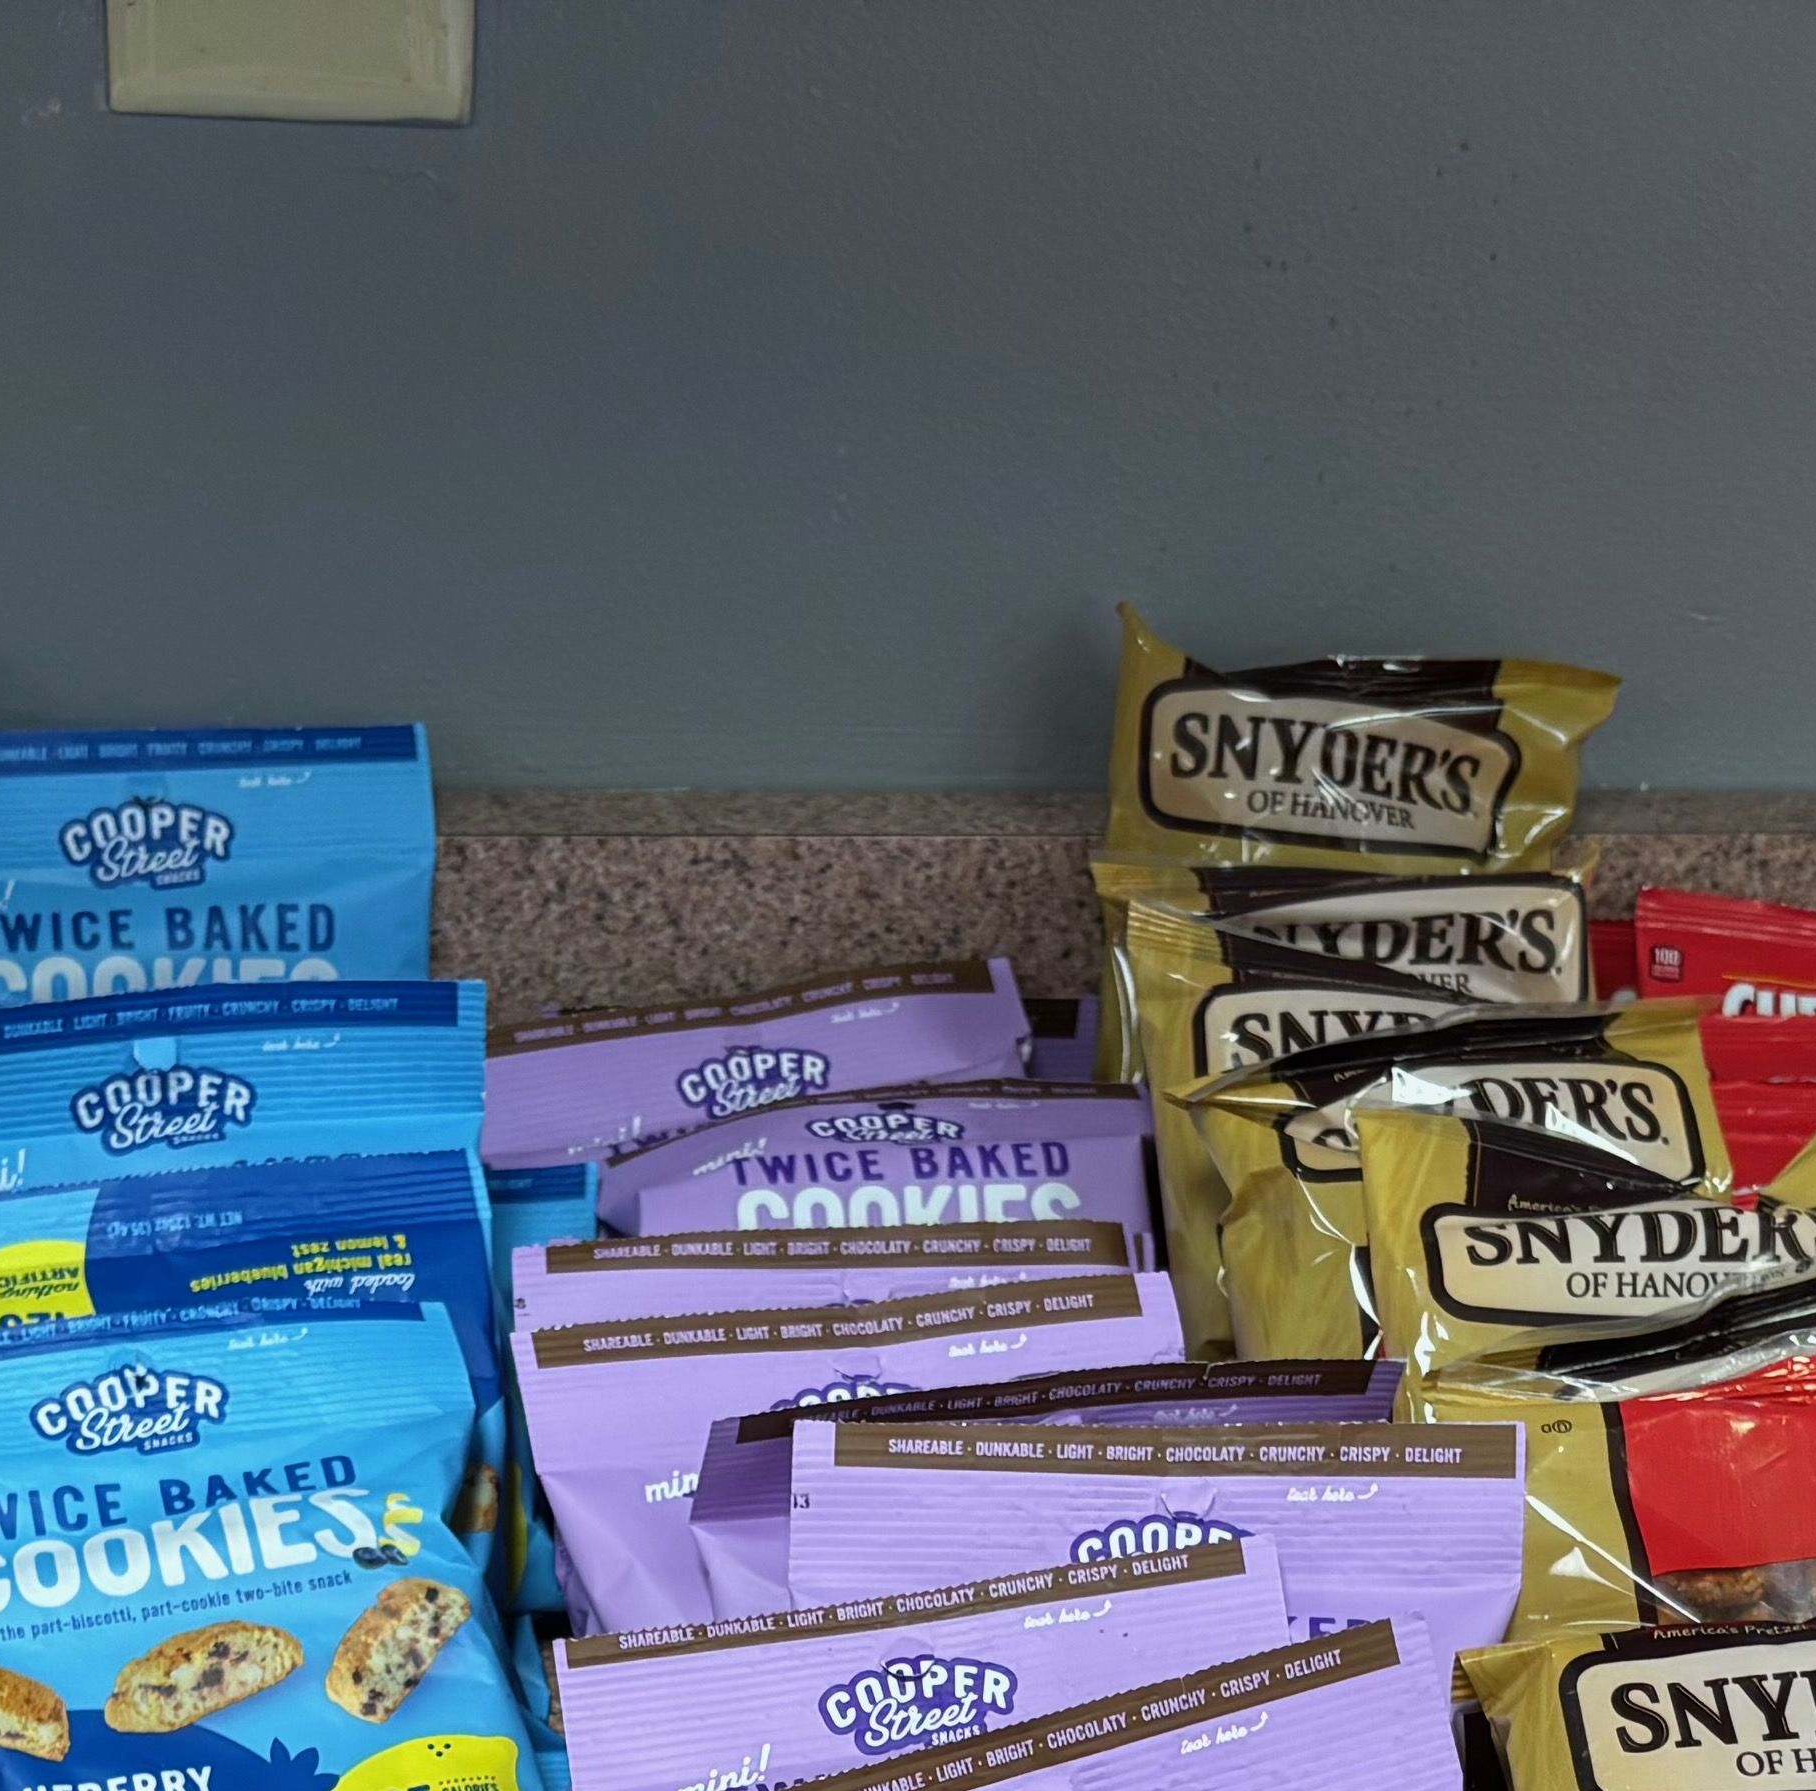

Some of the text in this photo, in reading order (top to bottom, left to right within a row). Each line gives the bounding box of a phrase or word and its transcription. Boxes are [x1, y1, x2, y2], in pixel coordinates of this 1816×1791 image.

[63, 801, 231, 864] COOPER
[95, 836, 200, 882] Street
[166, 902, 336, 952] BAKED
[75, 1070, 252, 1130] COOPER
[681, 1049, 827, 1103] COOPER
[110, 1104, 221, 1149] Street
[732, 1141, 1071, 1187] TWICE BAKED
[292, 1235, 386, 1258] lemon zest
[1565, 1270, 1607, 1299] OF
[37, 1363, 228, 1432] COOPER
[75, 1402, 190, 1452] Street
[143, 1431, 194, 1452] SNACKS
[159, 1455, 357, 1519] BAKED
[825, 1657, 1013, 1722] COOPER
[867, 1686, 976, 1750] Street
[1735, 1749, 1785, 1778] OF
